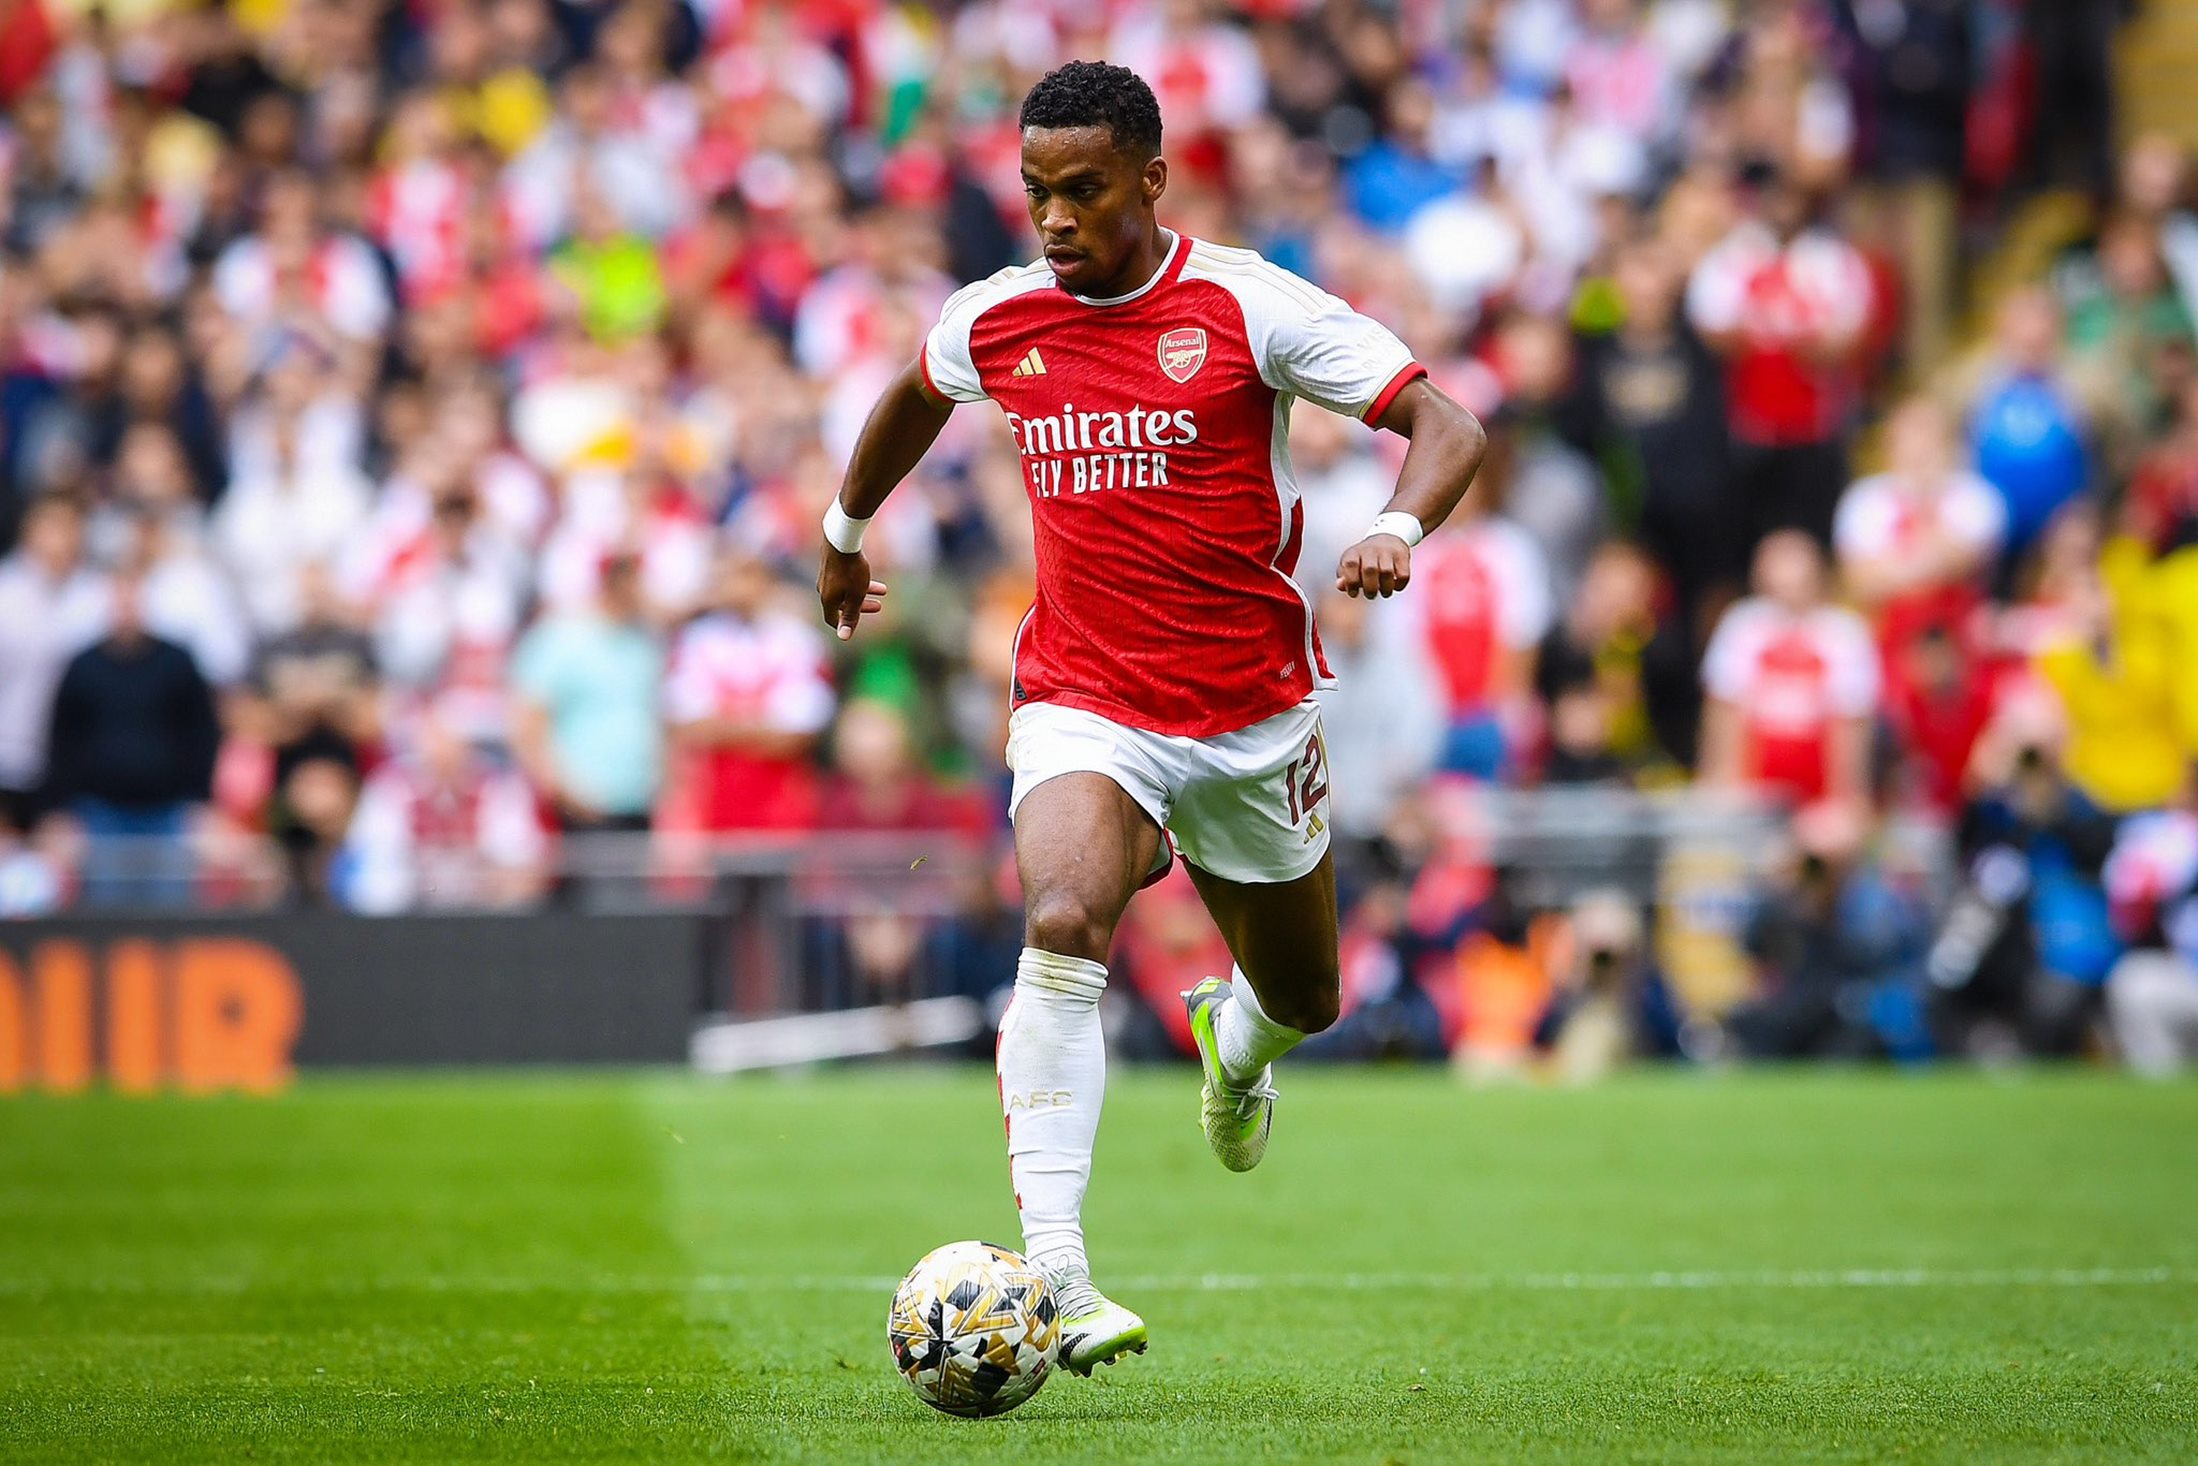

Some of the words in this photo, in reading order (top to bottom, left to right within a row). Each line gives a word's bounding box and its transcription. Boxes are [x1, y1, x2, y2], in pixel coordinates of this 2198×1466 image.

[1166, 336, 1200, 348] Arsenal
[1031, 459, 1062, 498] FLY
[1072, 452, 1169, 494] BETTER
[1286, 734, 1327, 827] 12
[1010, 1090, 1072, 1110] AFC
